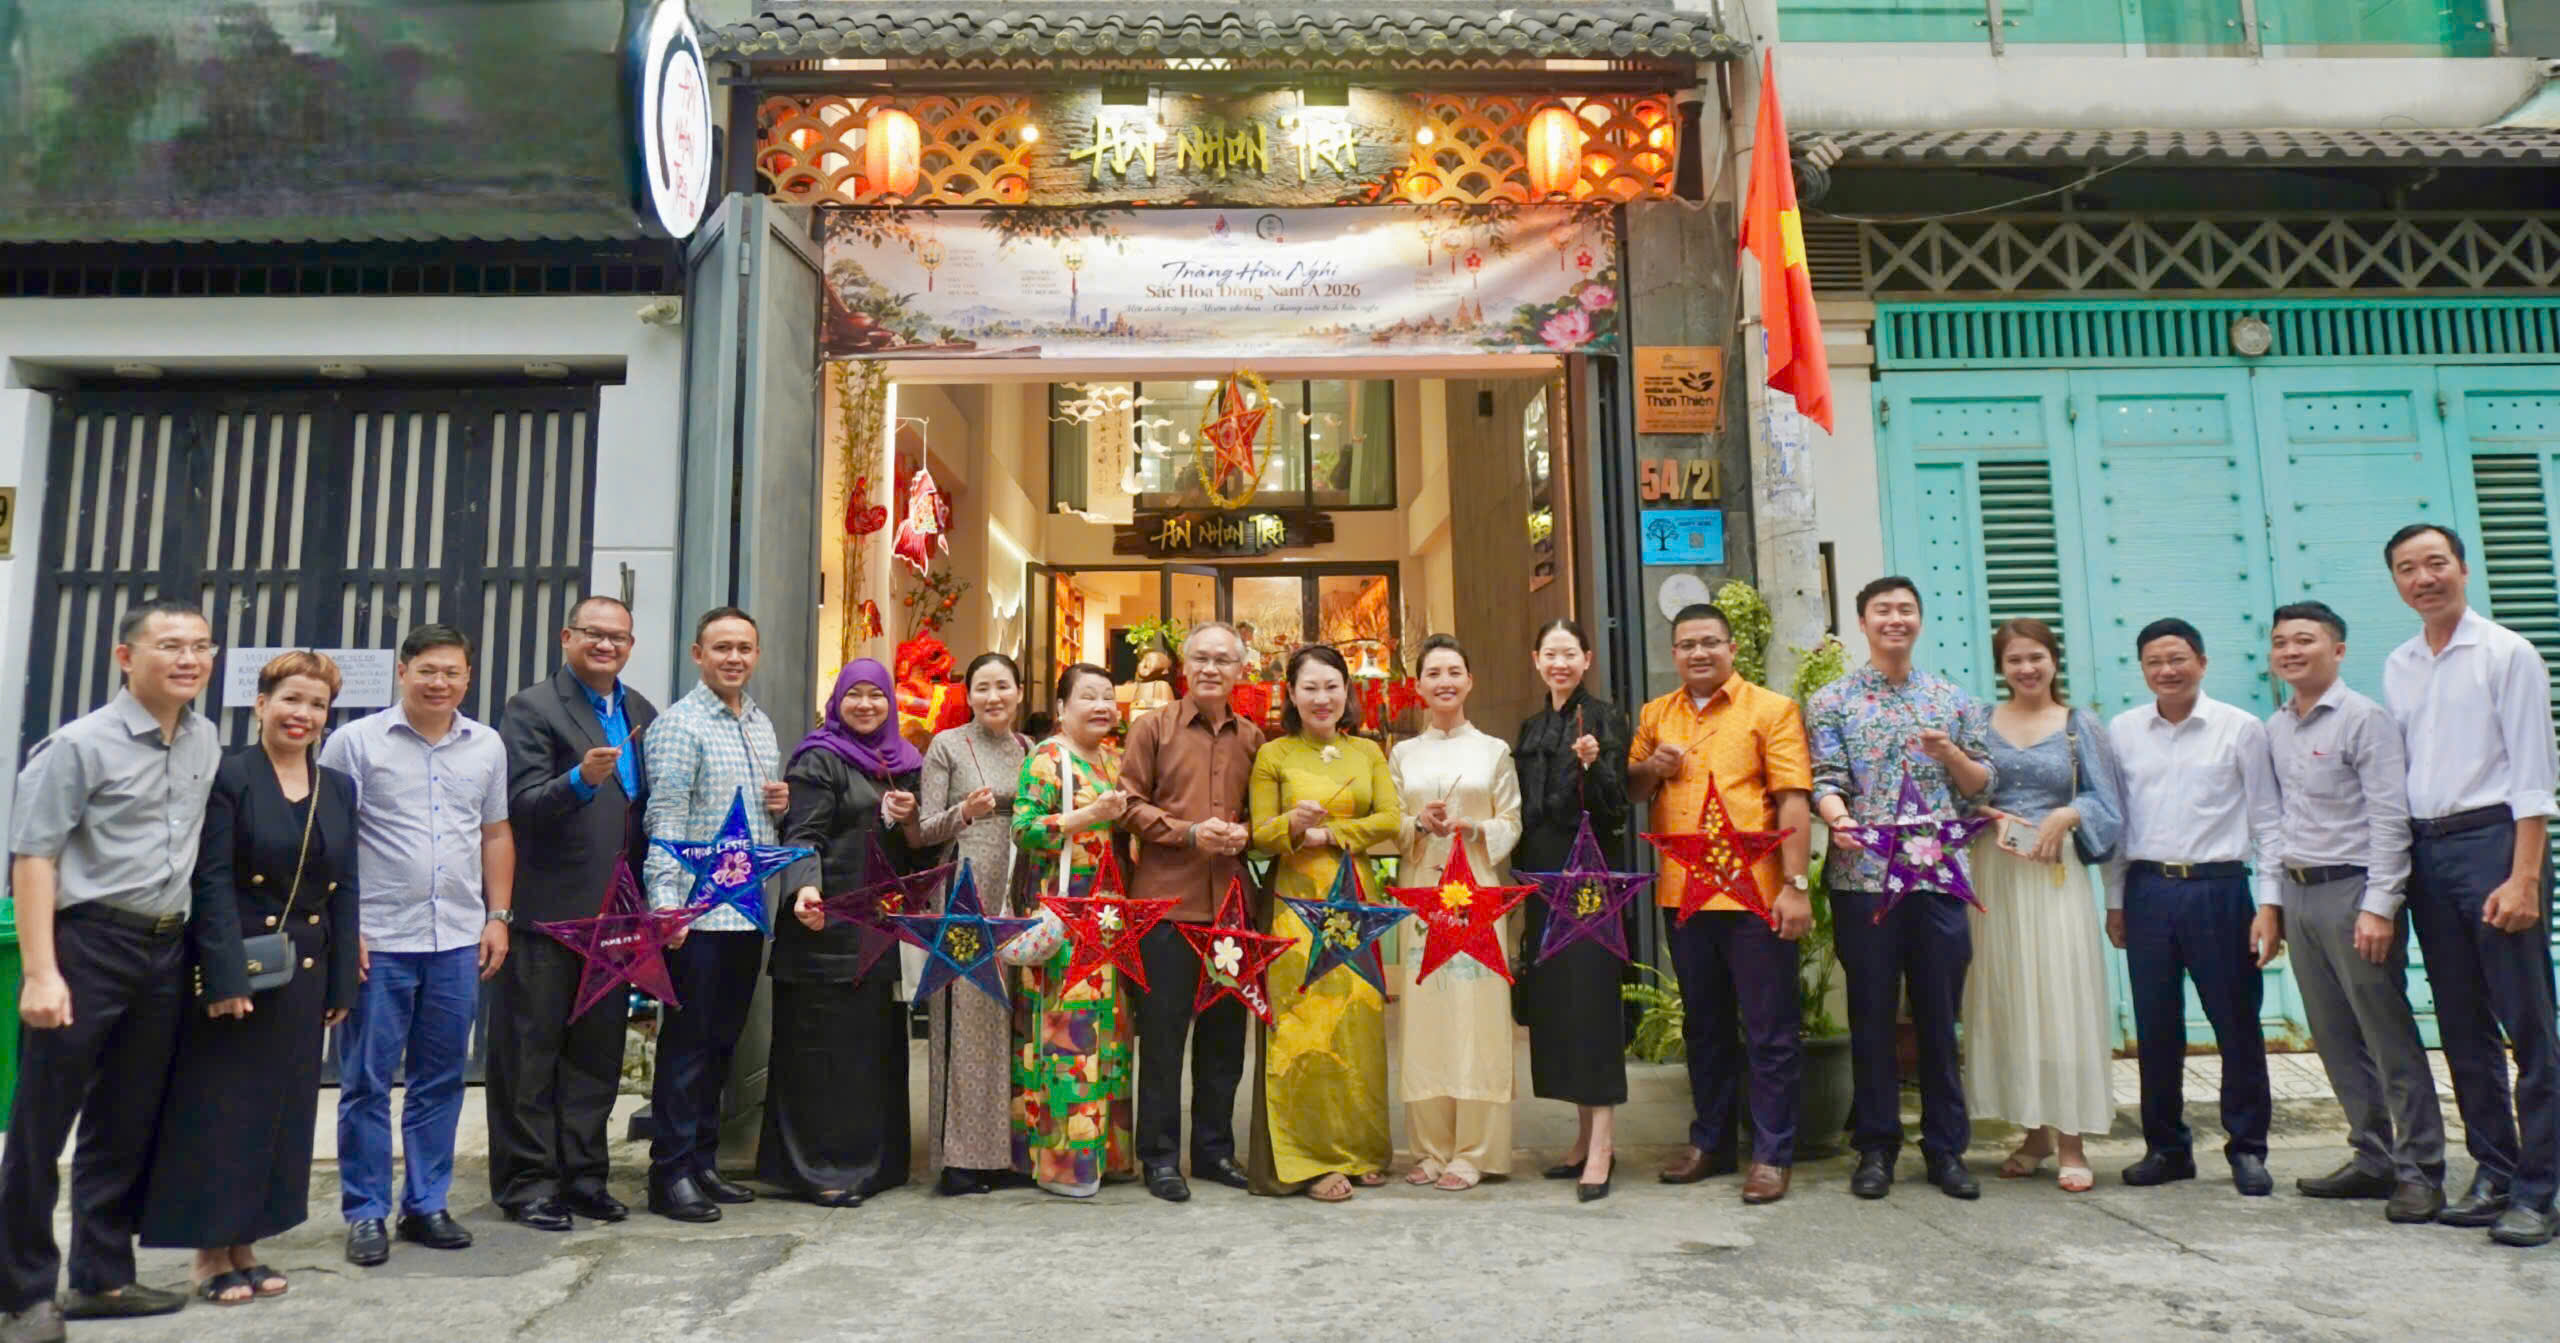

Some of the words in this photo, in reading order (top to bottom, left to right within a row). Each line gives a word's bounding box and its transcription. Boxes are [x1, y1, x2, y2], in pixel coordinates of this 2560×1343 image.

[1180, 283, 1214, 298] Hoa
[1324, 282, 1362, 298] 2026
[1640, 457, 1721, 501] 54/21
